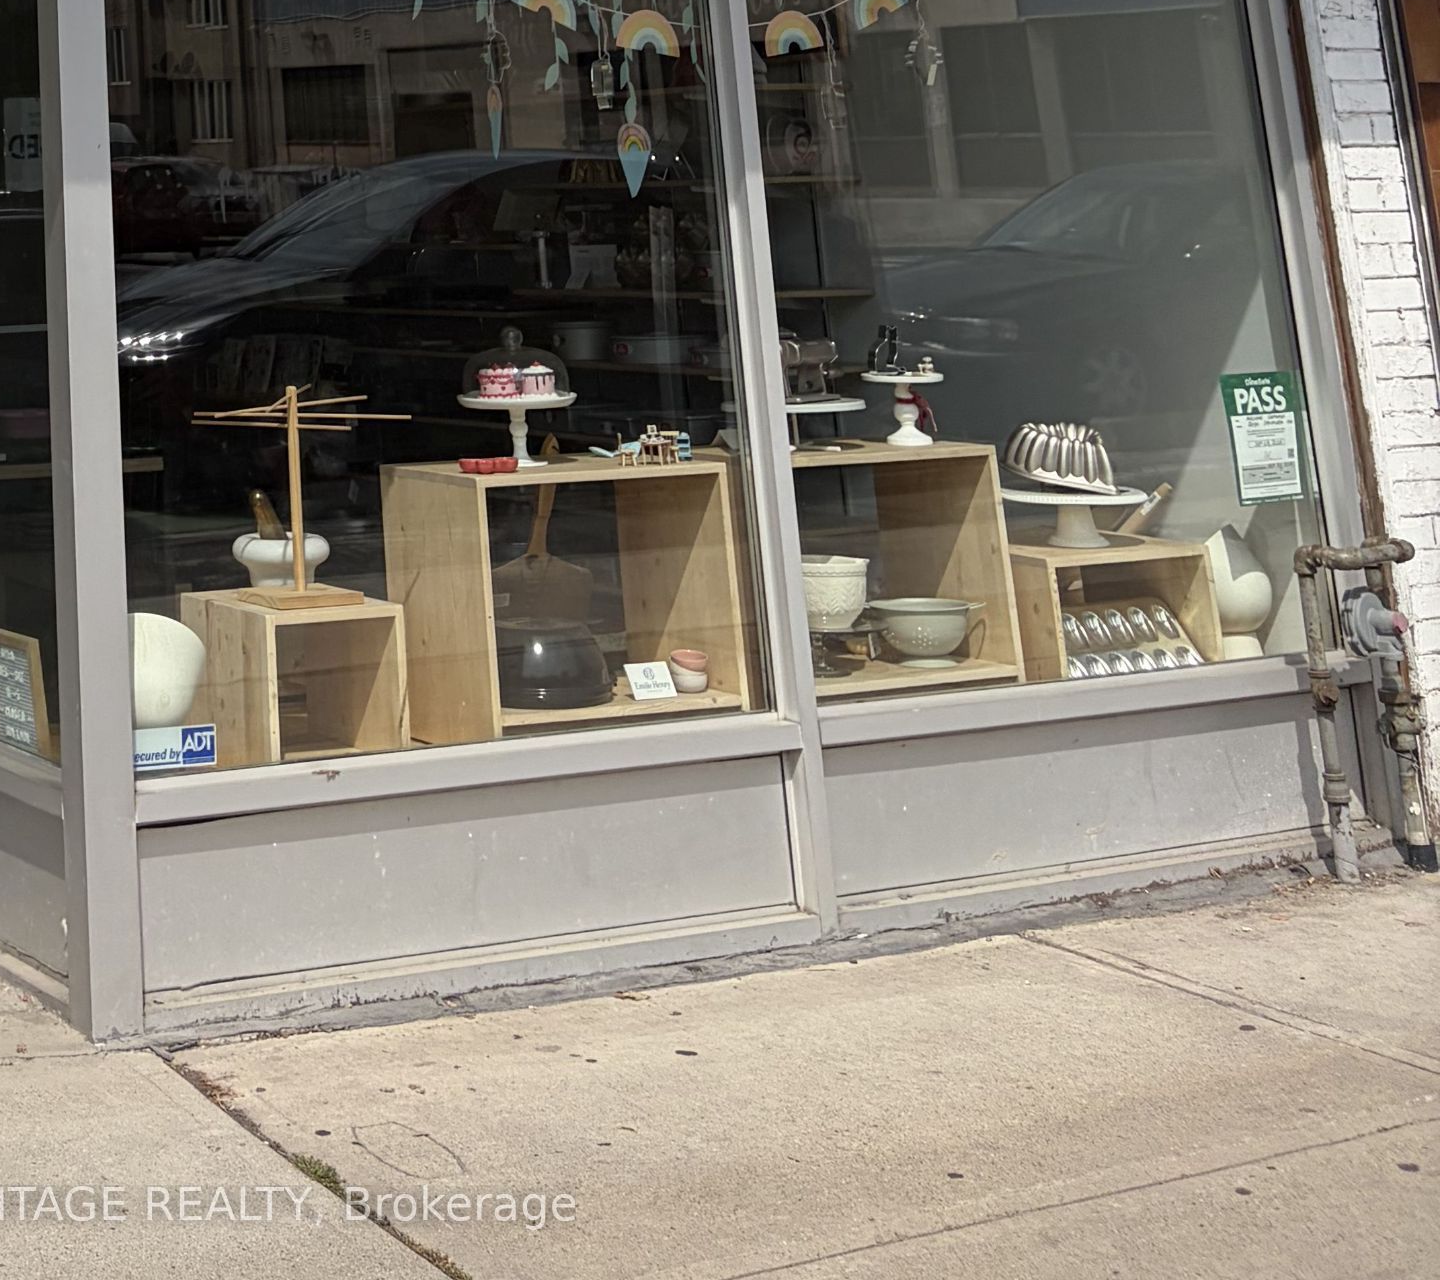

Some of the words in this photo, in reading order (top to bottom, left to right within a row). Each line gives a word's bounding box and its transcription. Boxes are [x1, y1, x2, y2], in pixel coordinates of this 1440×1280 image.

[1233, 385, 1287, 414] PASS
[182, 731, 215, 752] ADT
[133, 749, 167, 763] ecured
[169, 748, 181, 762] by
